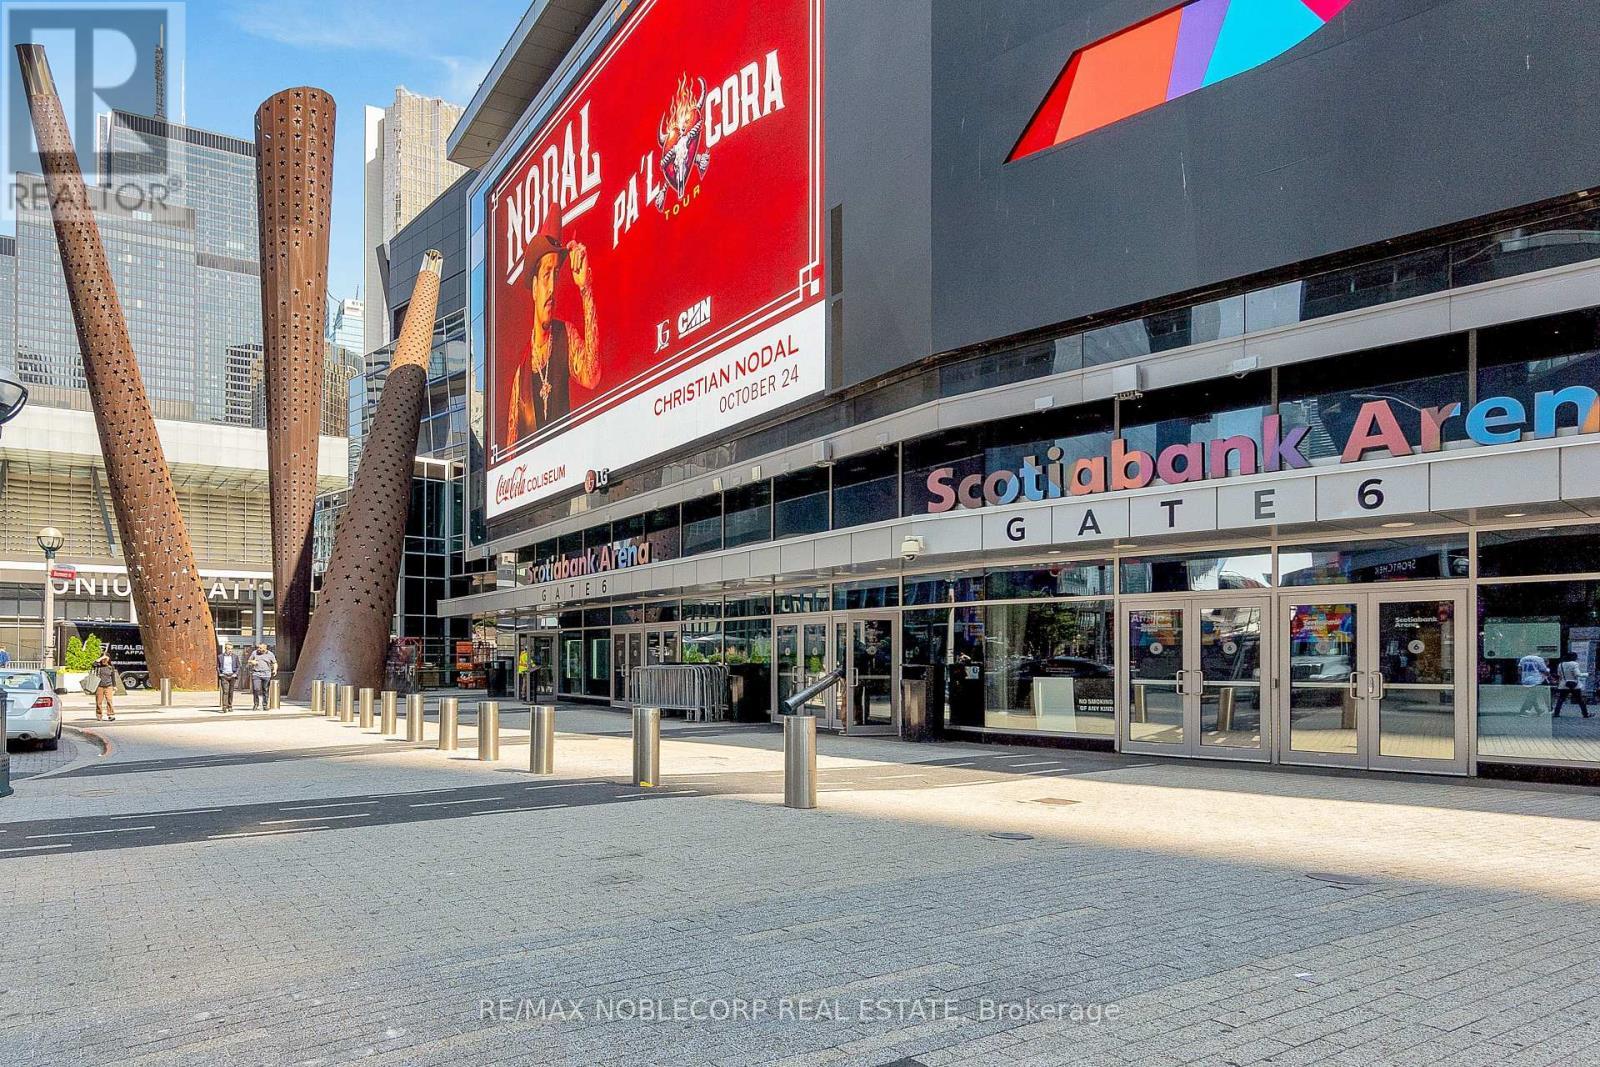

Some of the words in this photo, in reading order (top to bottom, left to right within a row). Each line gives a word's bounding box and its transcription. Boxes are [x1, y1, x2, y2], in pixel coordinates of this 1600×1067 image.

[612, 151, 661, 250] PA'L
[704, 49, 785, 148] CORA
[506, 100, 601, 275] NODAL
[665, 185, 700, 220] TOUR
[654, 365, 730, 416] CHRISTIAN
[735, 335, 799, 380] NODAL
[719, 374, 776, 413] OCTOBER
[782, 364, 799, 388] 24
[527, 464, 566, 492] COLISEUM
[927, 414, 1311, 513] Scotiabank
[1006, 488, 1276, 541] GATE
[1357, 478, 1384, 509] 6
[53, 573, 132, 597] UNIO
[206, 577, 274, 600] ATIO
[528, 547, 596, 584] Scotiabank
[600, 542, 649, 572] Arena
[542, 582, 590, 601] GATE
[602, 580, 607, 593] 6
